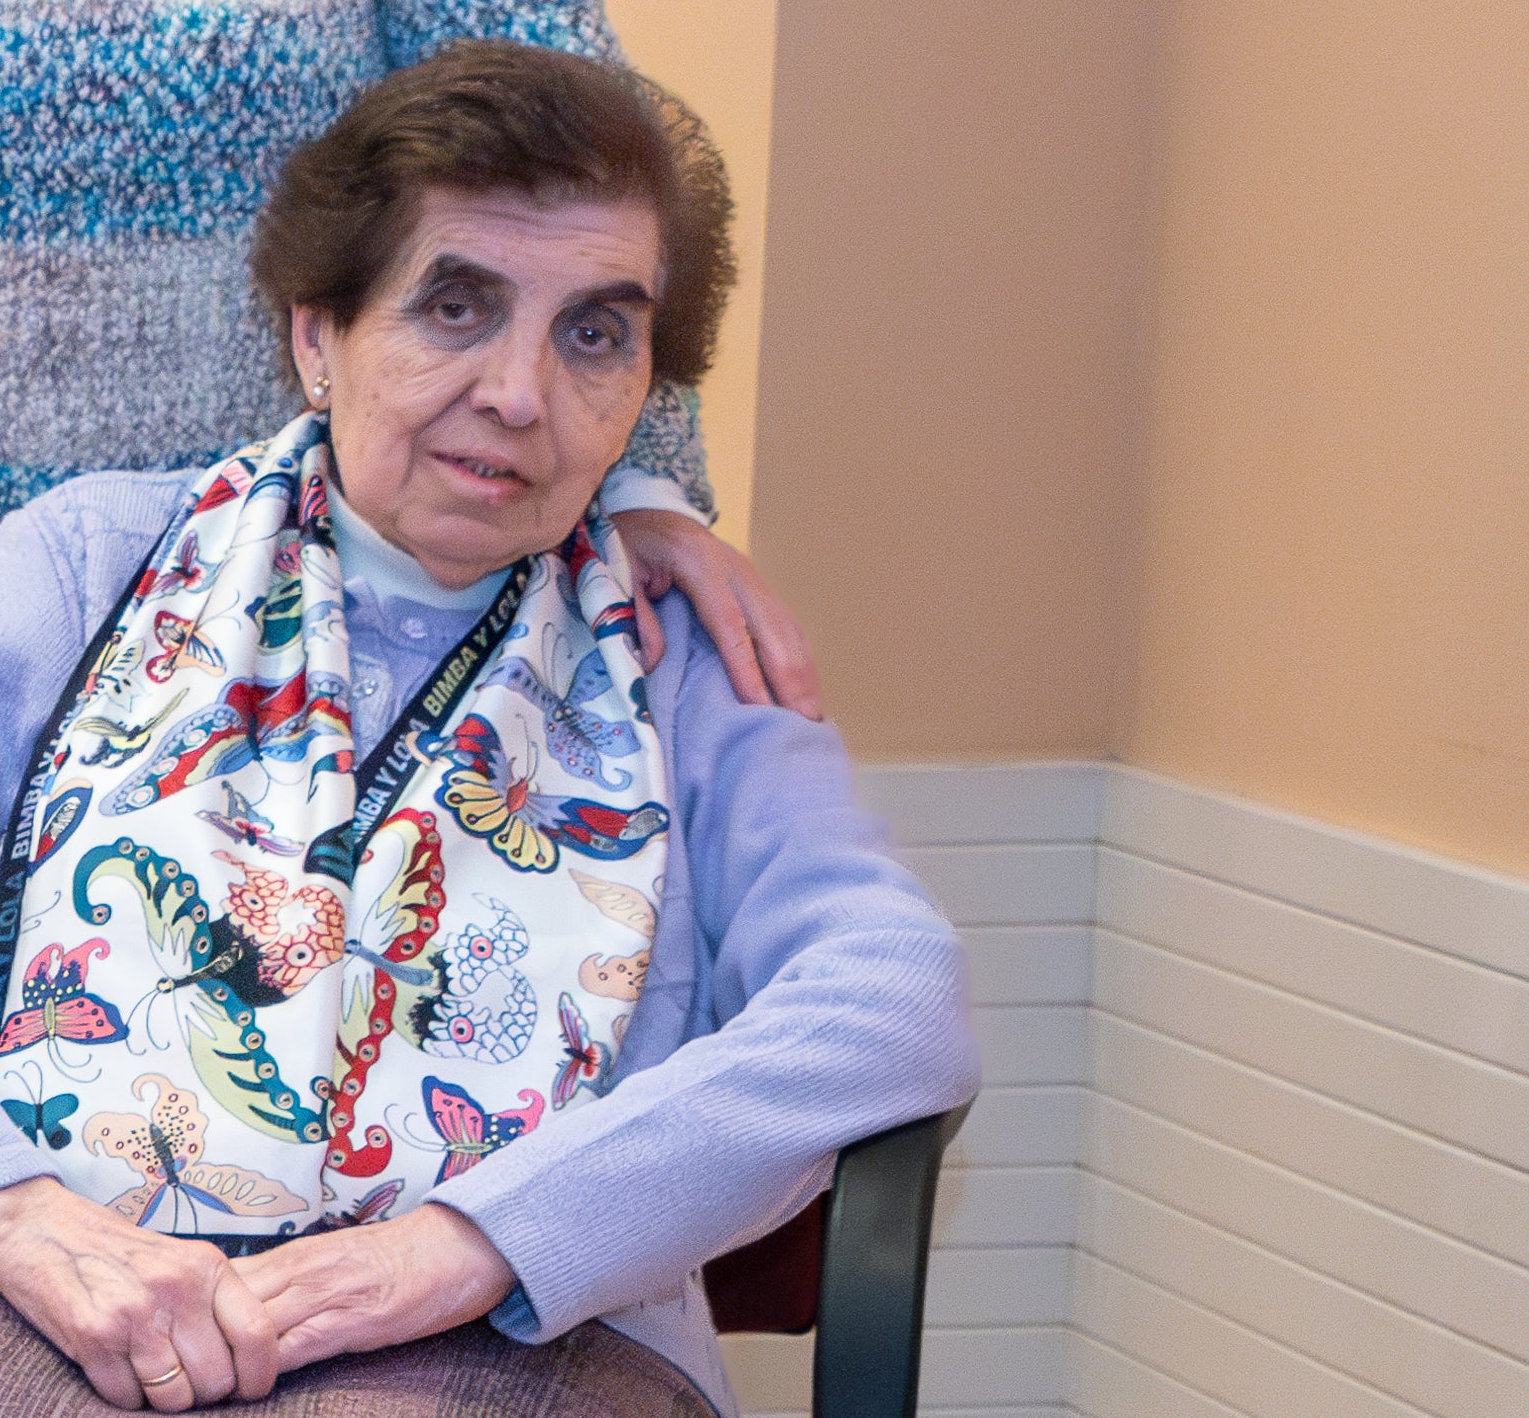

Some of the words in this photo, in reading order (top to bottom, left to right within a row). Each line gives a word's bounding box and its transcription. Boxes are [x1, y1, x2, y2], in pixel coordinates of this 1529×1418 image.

[423, 647, 478, 717] BIMBA
[473, 626, 488, 648] Y
[385, 718, 429, 772] LOA
[374, 765, 397, 786] Y
[11, 772, 48, 859] BIMBA
[354, 787, 392, 842] IMBA
